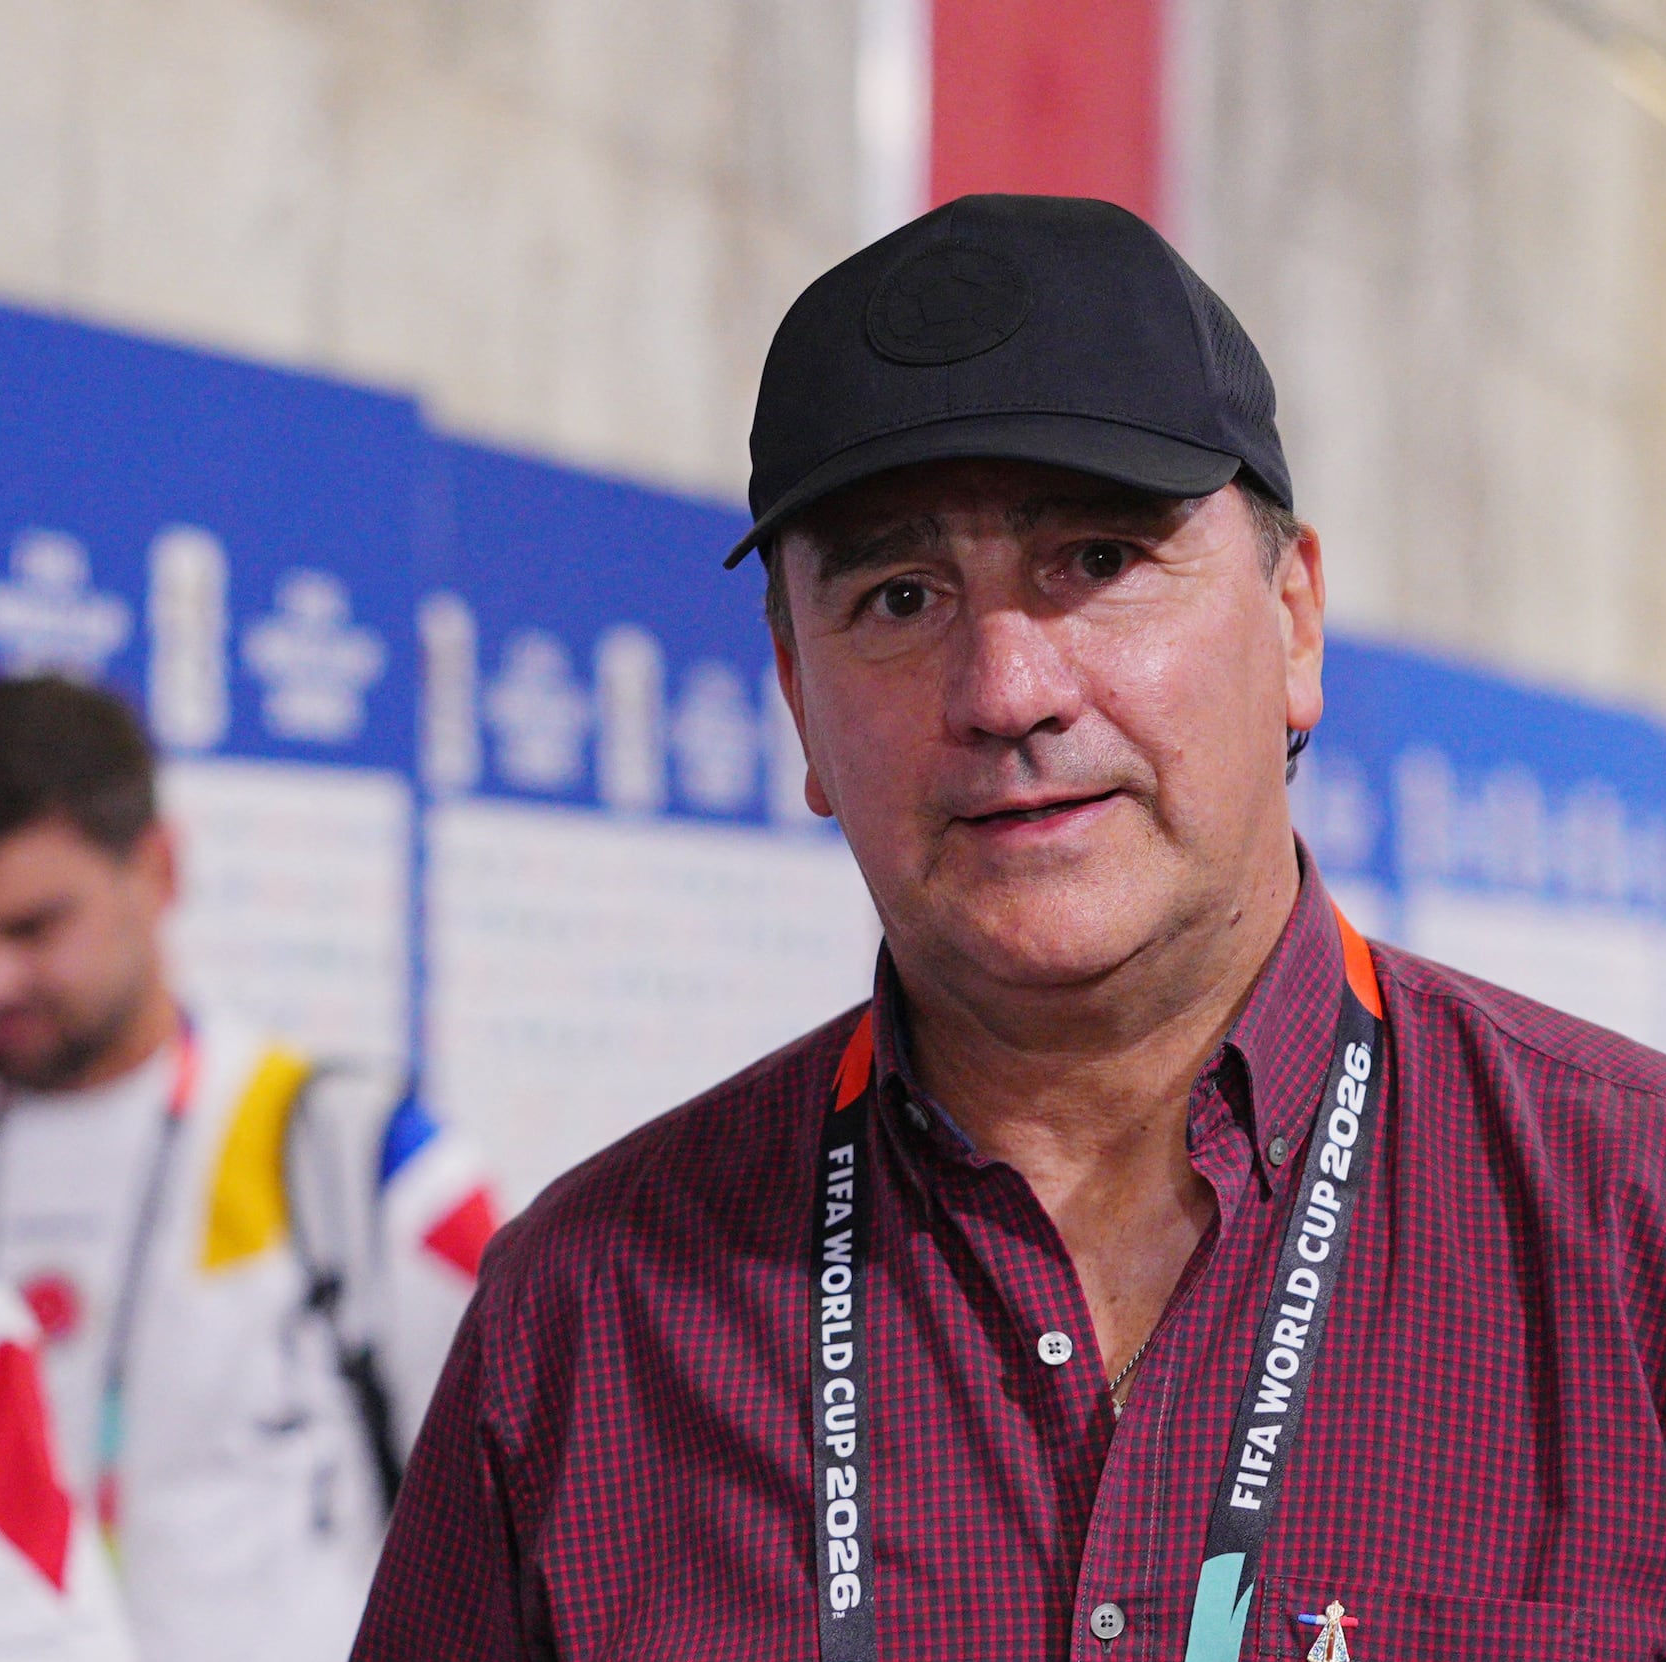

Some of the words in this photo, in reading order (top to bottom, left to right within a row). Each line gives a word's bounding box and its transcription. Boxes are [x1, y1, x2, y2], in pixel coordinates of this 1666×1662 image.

[824, 1142, 855, 1228] FIFA
[1297, 1180, 1342, 1264] CUP
[820, 1228, 854, 1371] WORLD
[1253, 1267, 1321, 1414] WORLD
[823, 1377, 857, 1458] CUP
[1230, 1424, 1283, 1511] FIFA
